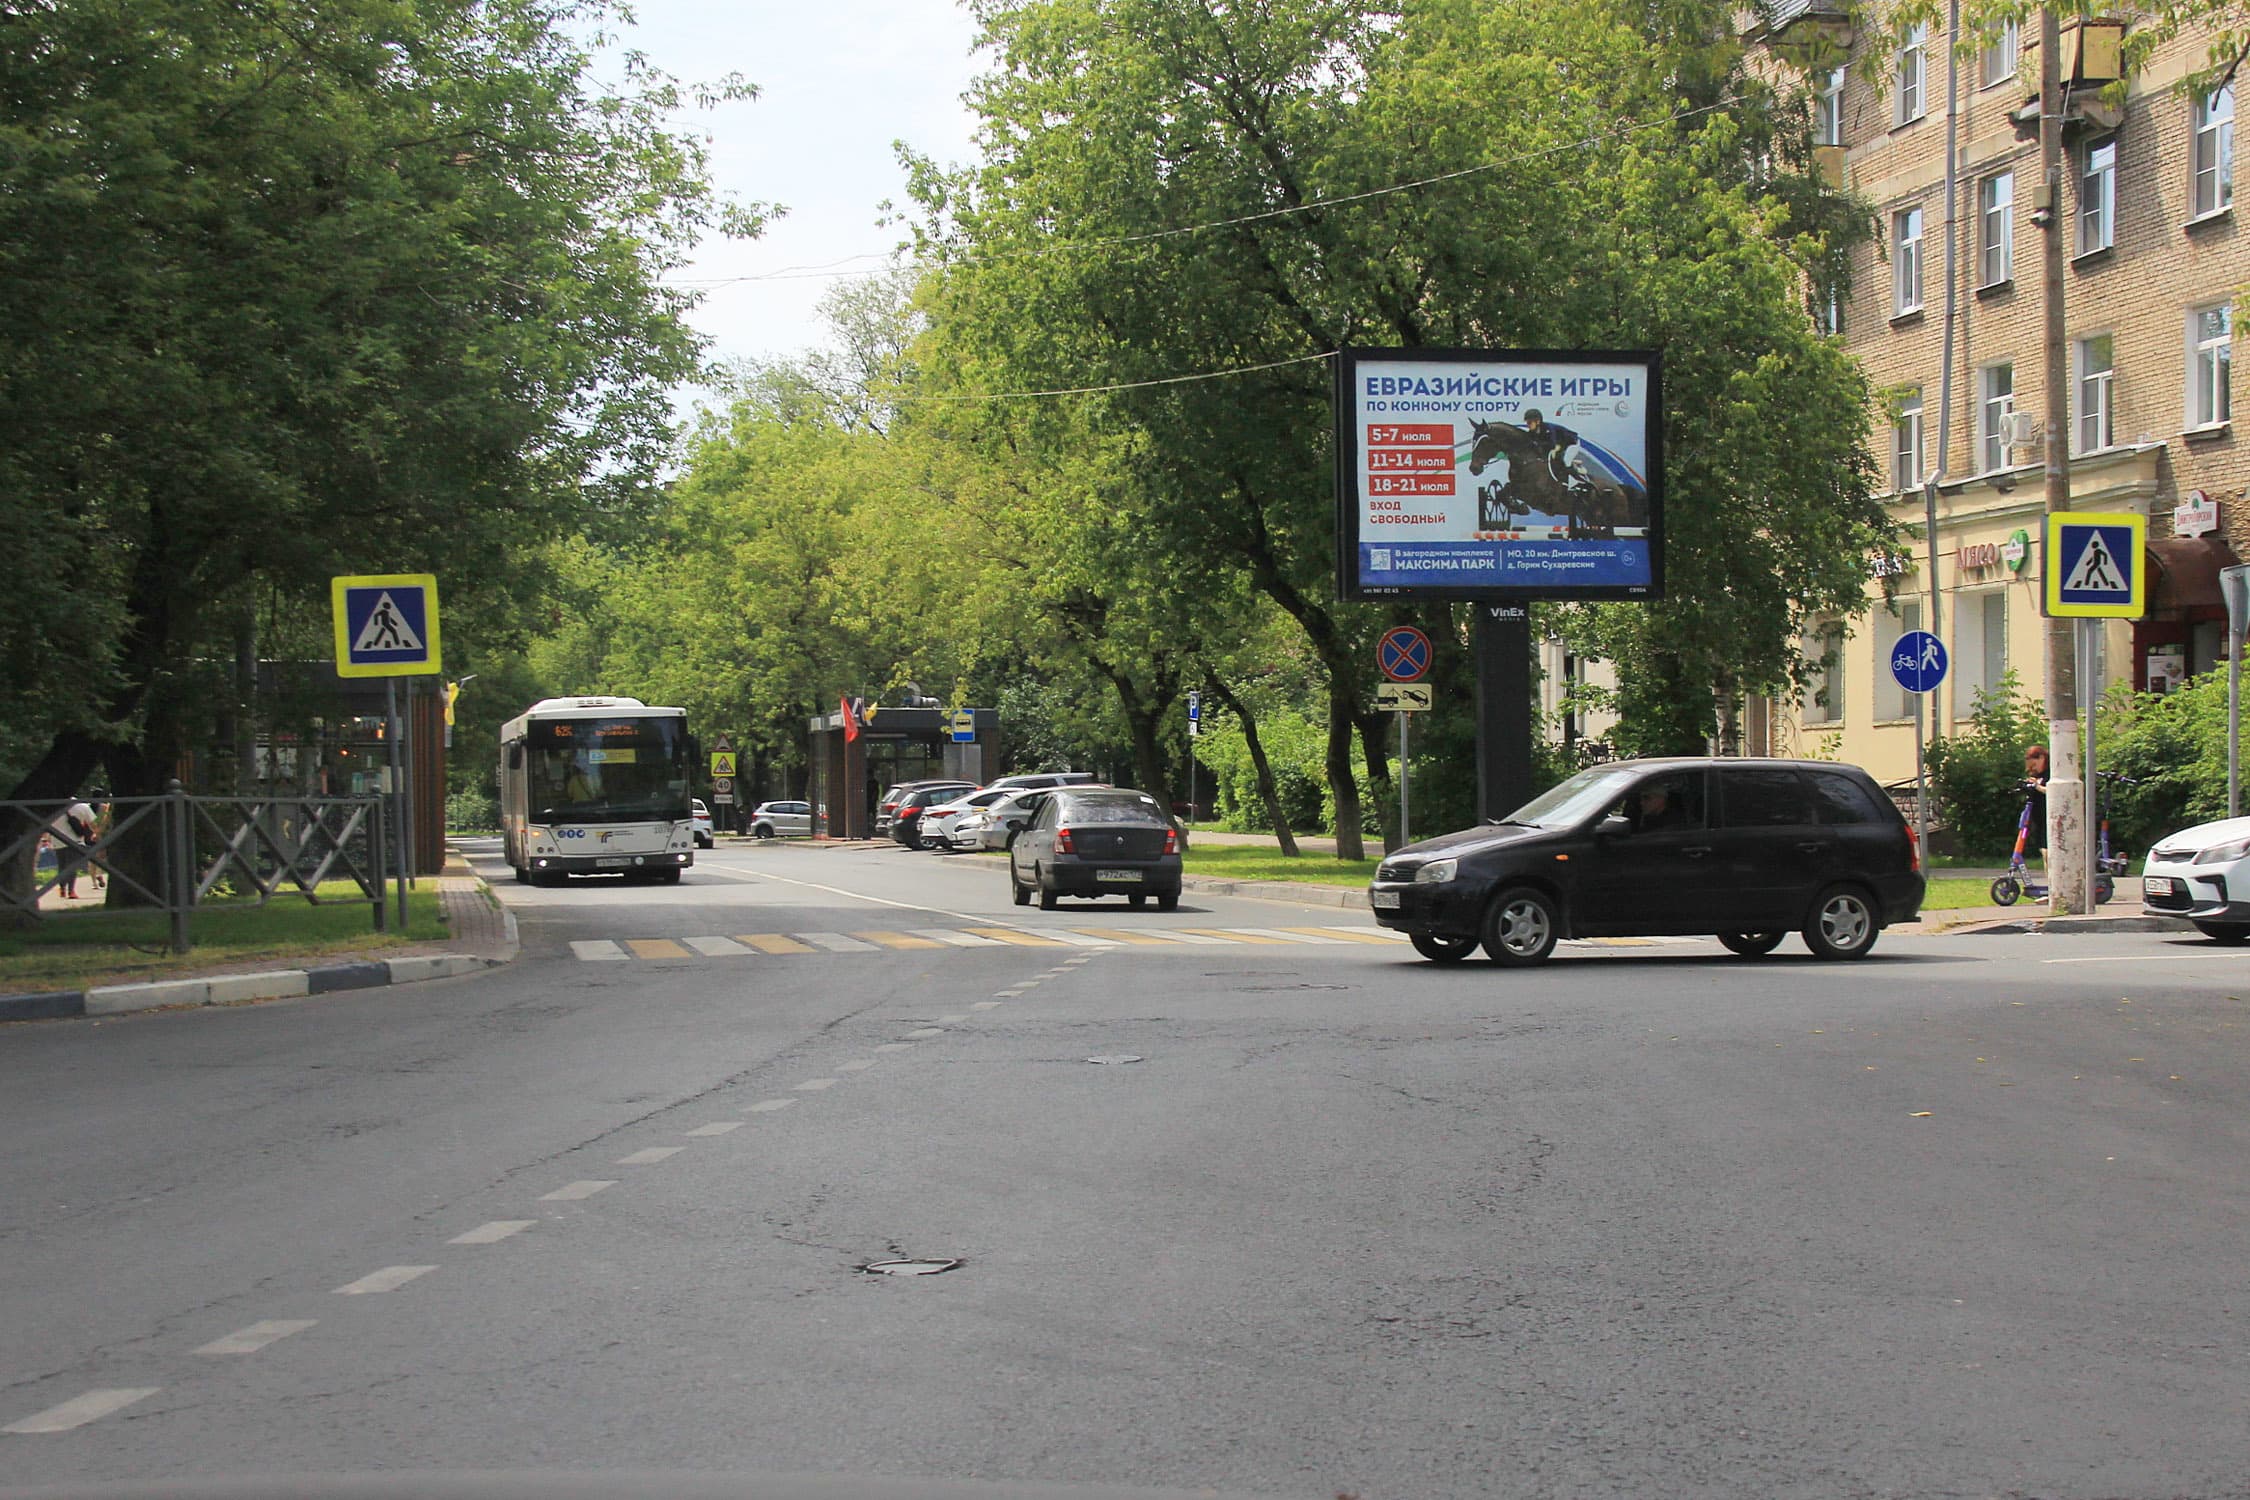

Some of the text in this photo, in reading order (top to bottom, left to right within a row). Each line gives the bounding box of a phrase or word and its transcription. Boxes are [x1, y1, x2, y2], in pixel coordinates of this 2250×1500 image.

[1366, 373, 1631, 397] ЕВРАЗИЙСКИЕ ИГРЫ
[1366, 401, 1521, 412] ПО КОННОМУ СПОРТУ
[1372, 428, 1431, 441] 5-7 июля
[1372, 453, 1446, 467] 11-14 июля
[1374, 478, 1449, 492] 18-21 июля
[1369, 501, 1401, 511] ВХОД
[1369, 512, 1445, 524] СВОБОДНЫЙ
[1403, 550, 1450, 558] загородном
[1551, 550, 1606, 560] Дмитровское
[1395, 559, 1495, 570] МАКСИМА ПАРК
[1490, 607, 1525, 617] VinEx
[717, 780, 729, 789] 40
